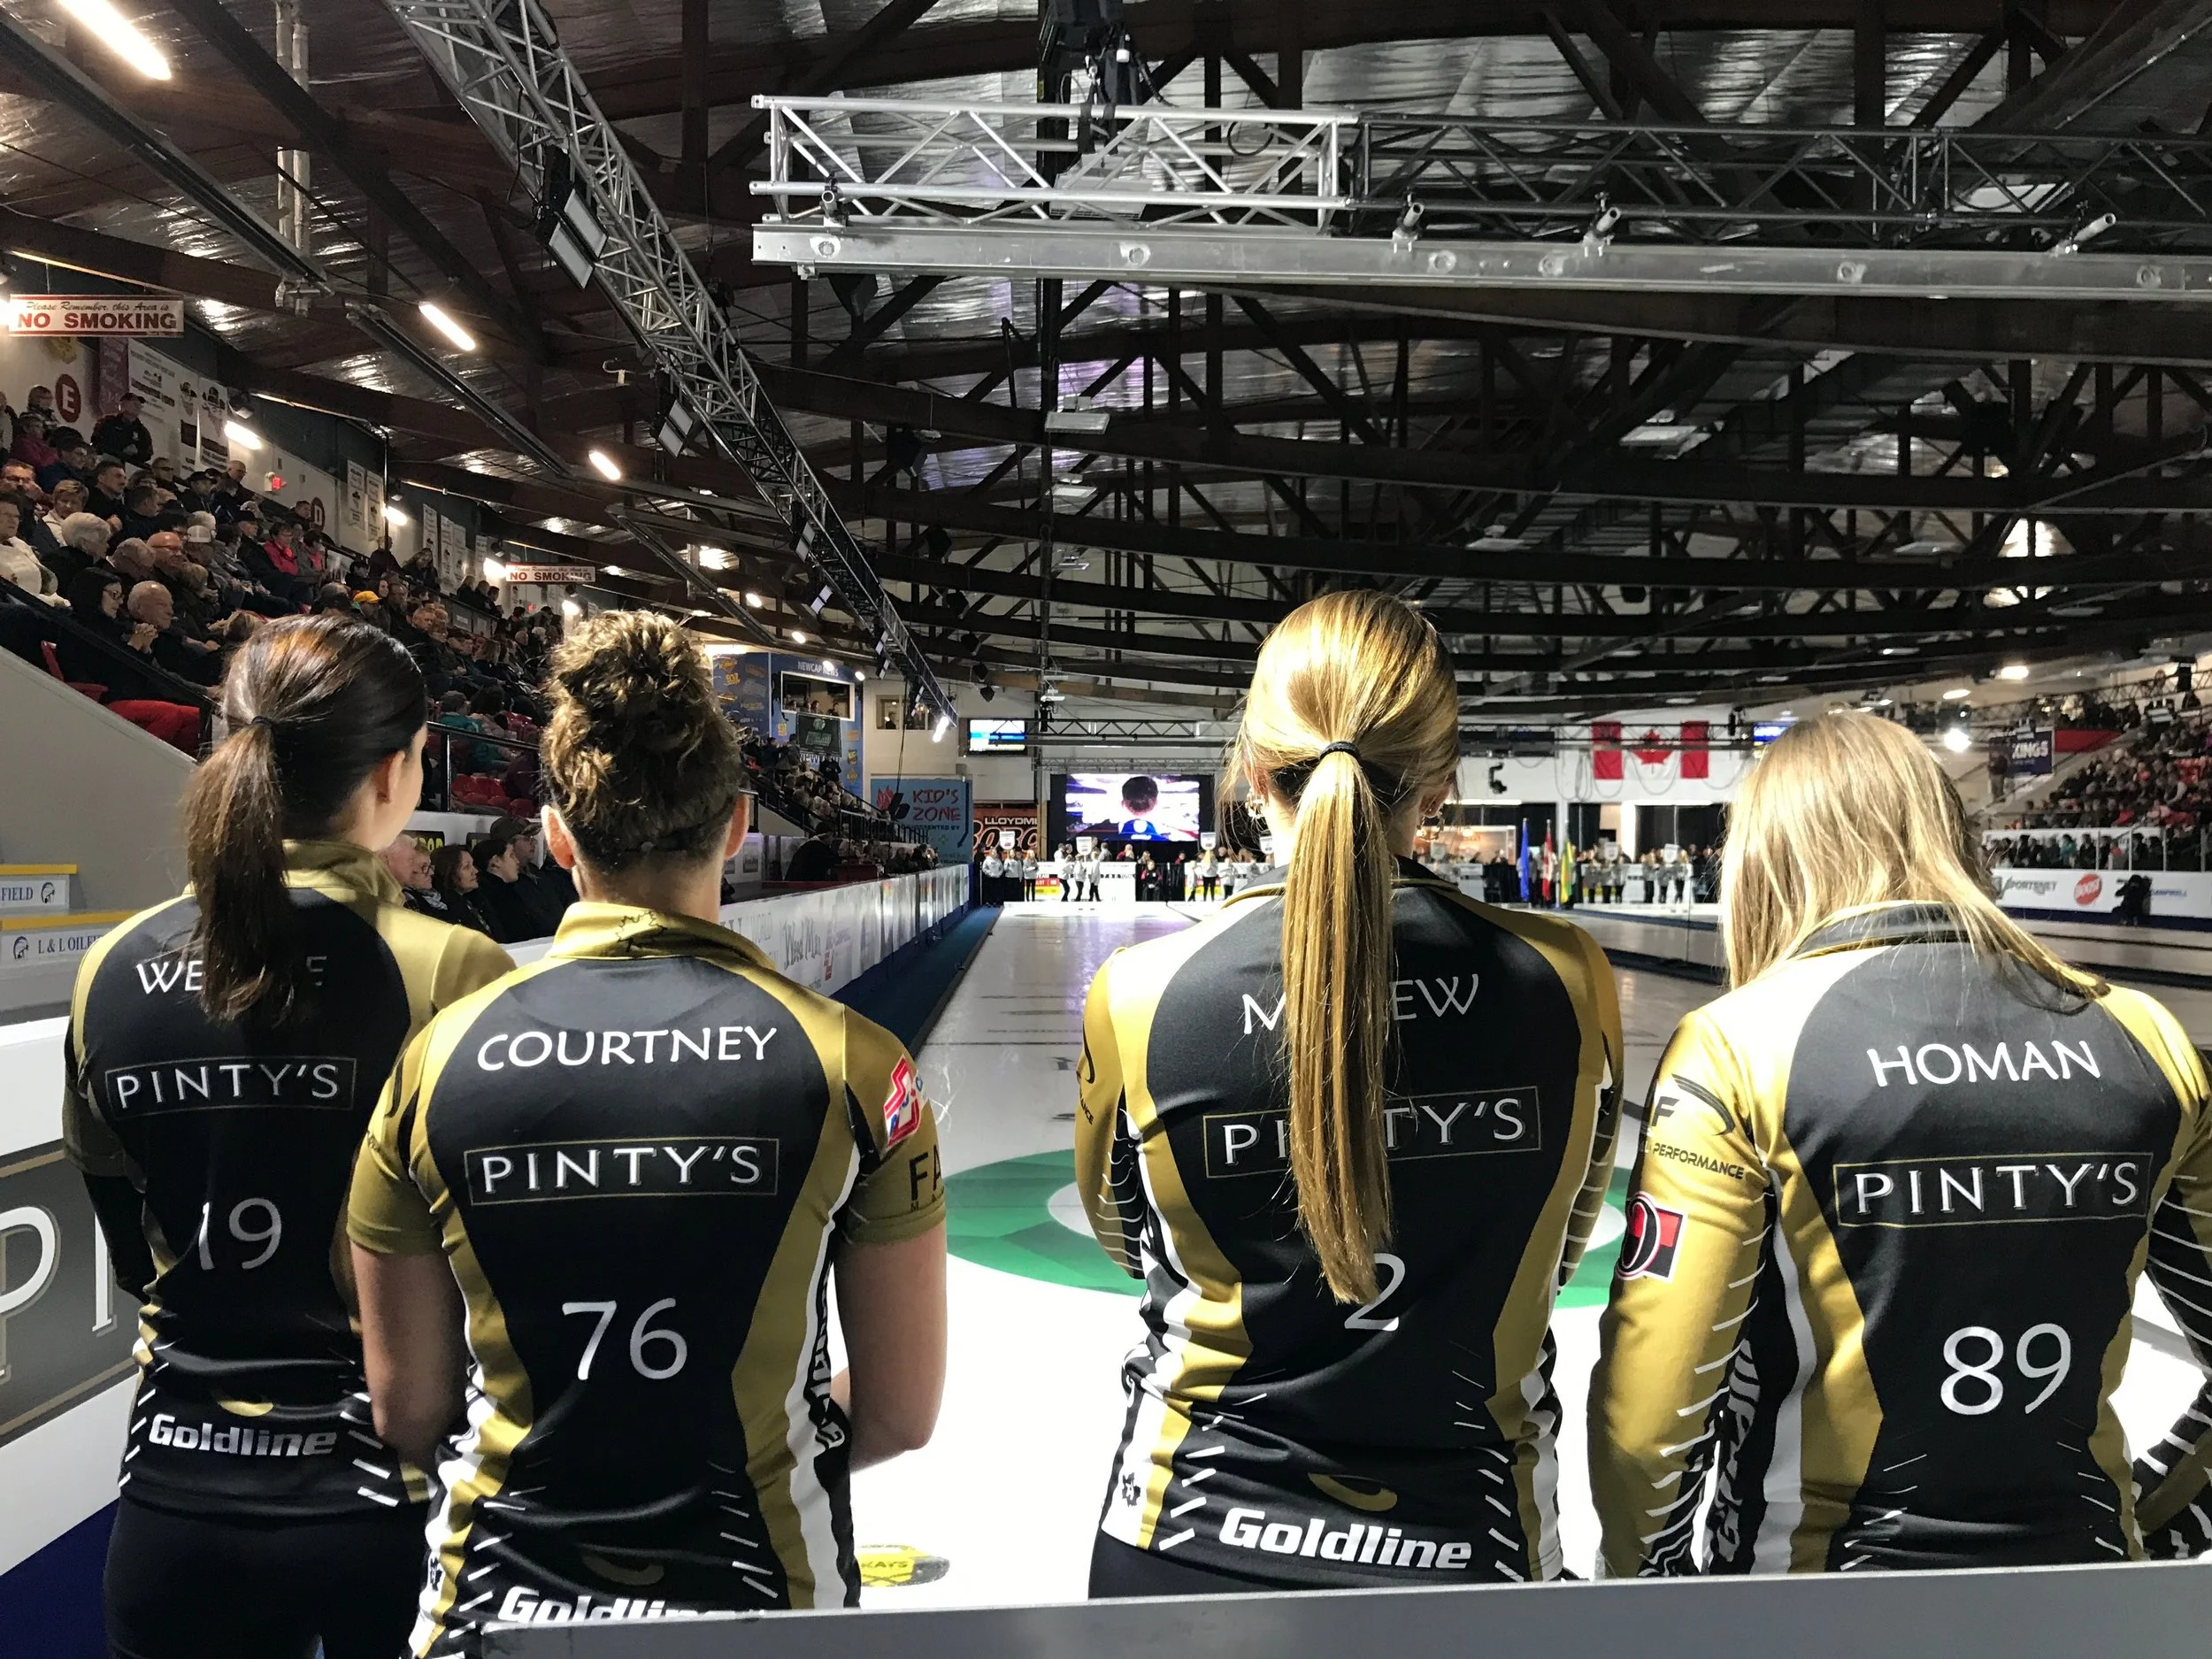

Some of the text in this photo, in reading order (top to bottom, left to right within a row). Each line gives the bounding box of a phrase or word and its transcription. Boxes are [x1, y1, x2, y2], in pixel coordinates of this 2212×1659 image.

[18, 312, 177, 329] NO SMOKING
[112, 301, 130, 311] this
[134, 301, 157, 311] Area
[161, 301, 170, 310] is
[62, 384, 75, 413] E
[510, 572, 592, 581] NO SMOKING
[797, 661, 823, 673] NEWCAP
[912, 788, 959, 804] KID'S
[912, 806, 961, 821] ZONE
[38, 940, 44, 955] L
[47, 938, 56, 953] &
[58, 938, 65, 952] L
[477, 1025, 778, 1071] COURTNEY
[1866, 1040, 2101, 1087] HOMAN
[116, 1063, 340, 1110] PINTY'S
[1223, 1097, 1526, 1167] PITY'S
[482, 1145, 763, 1194] PINTY'S
[1652, 1142, 1746, 1180] PERFORMANCE
[1853, 1162, 2141, 1217] PINTY'S
[198, 1197, 282, 1271] 19
[561, 1297, 688, 1381] 76
[1939, 1322, 2073, 1417] 89
[148, 1413, 338, 1457] Goldline
[1218, 1507, 1473, 1571] Goldline
